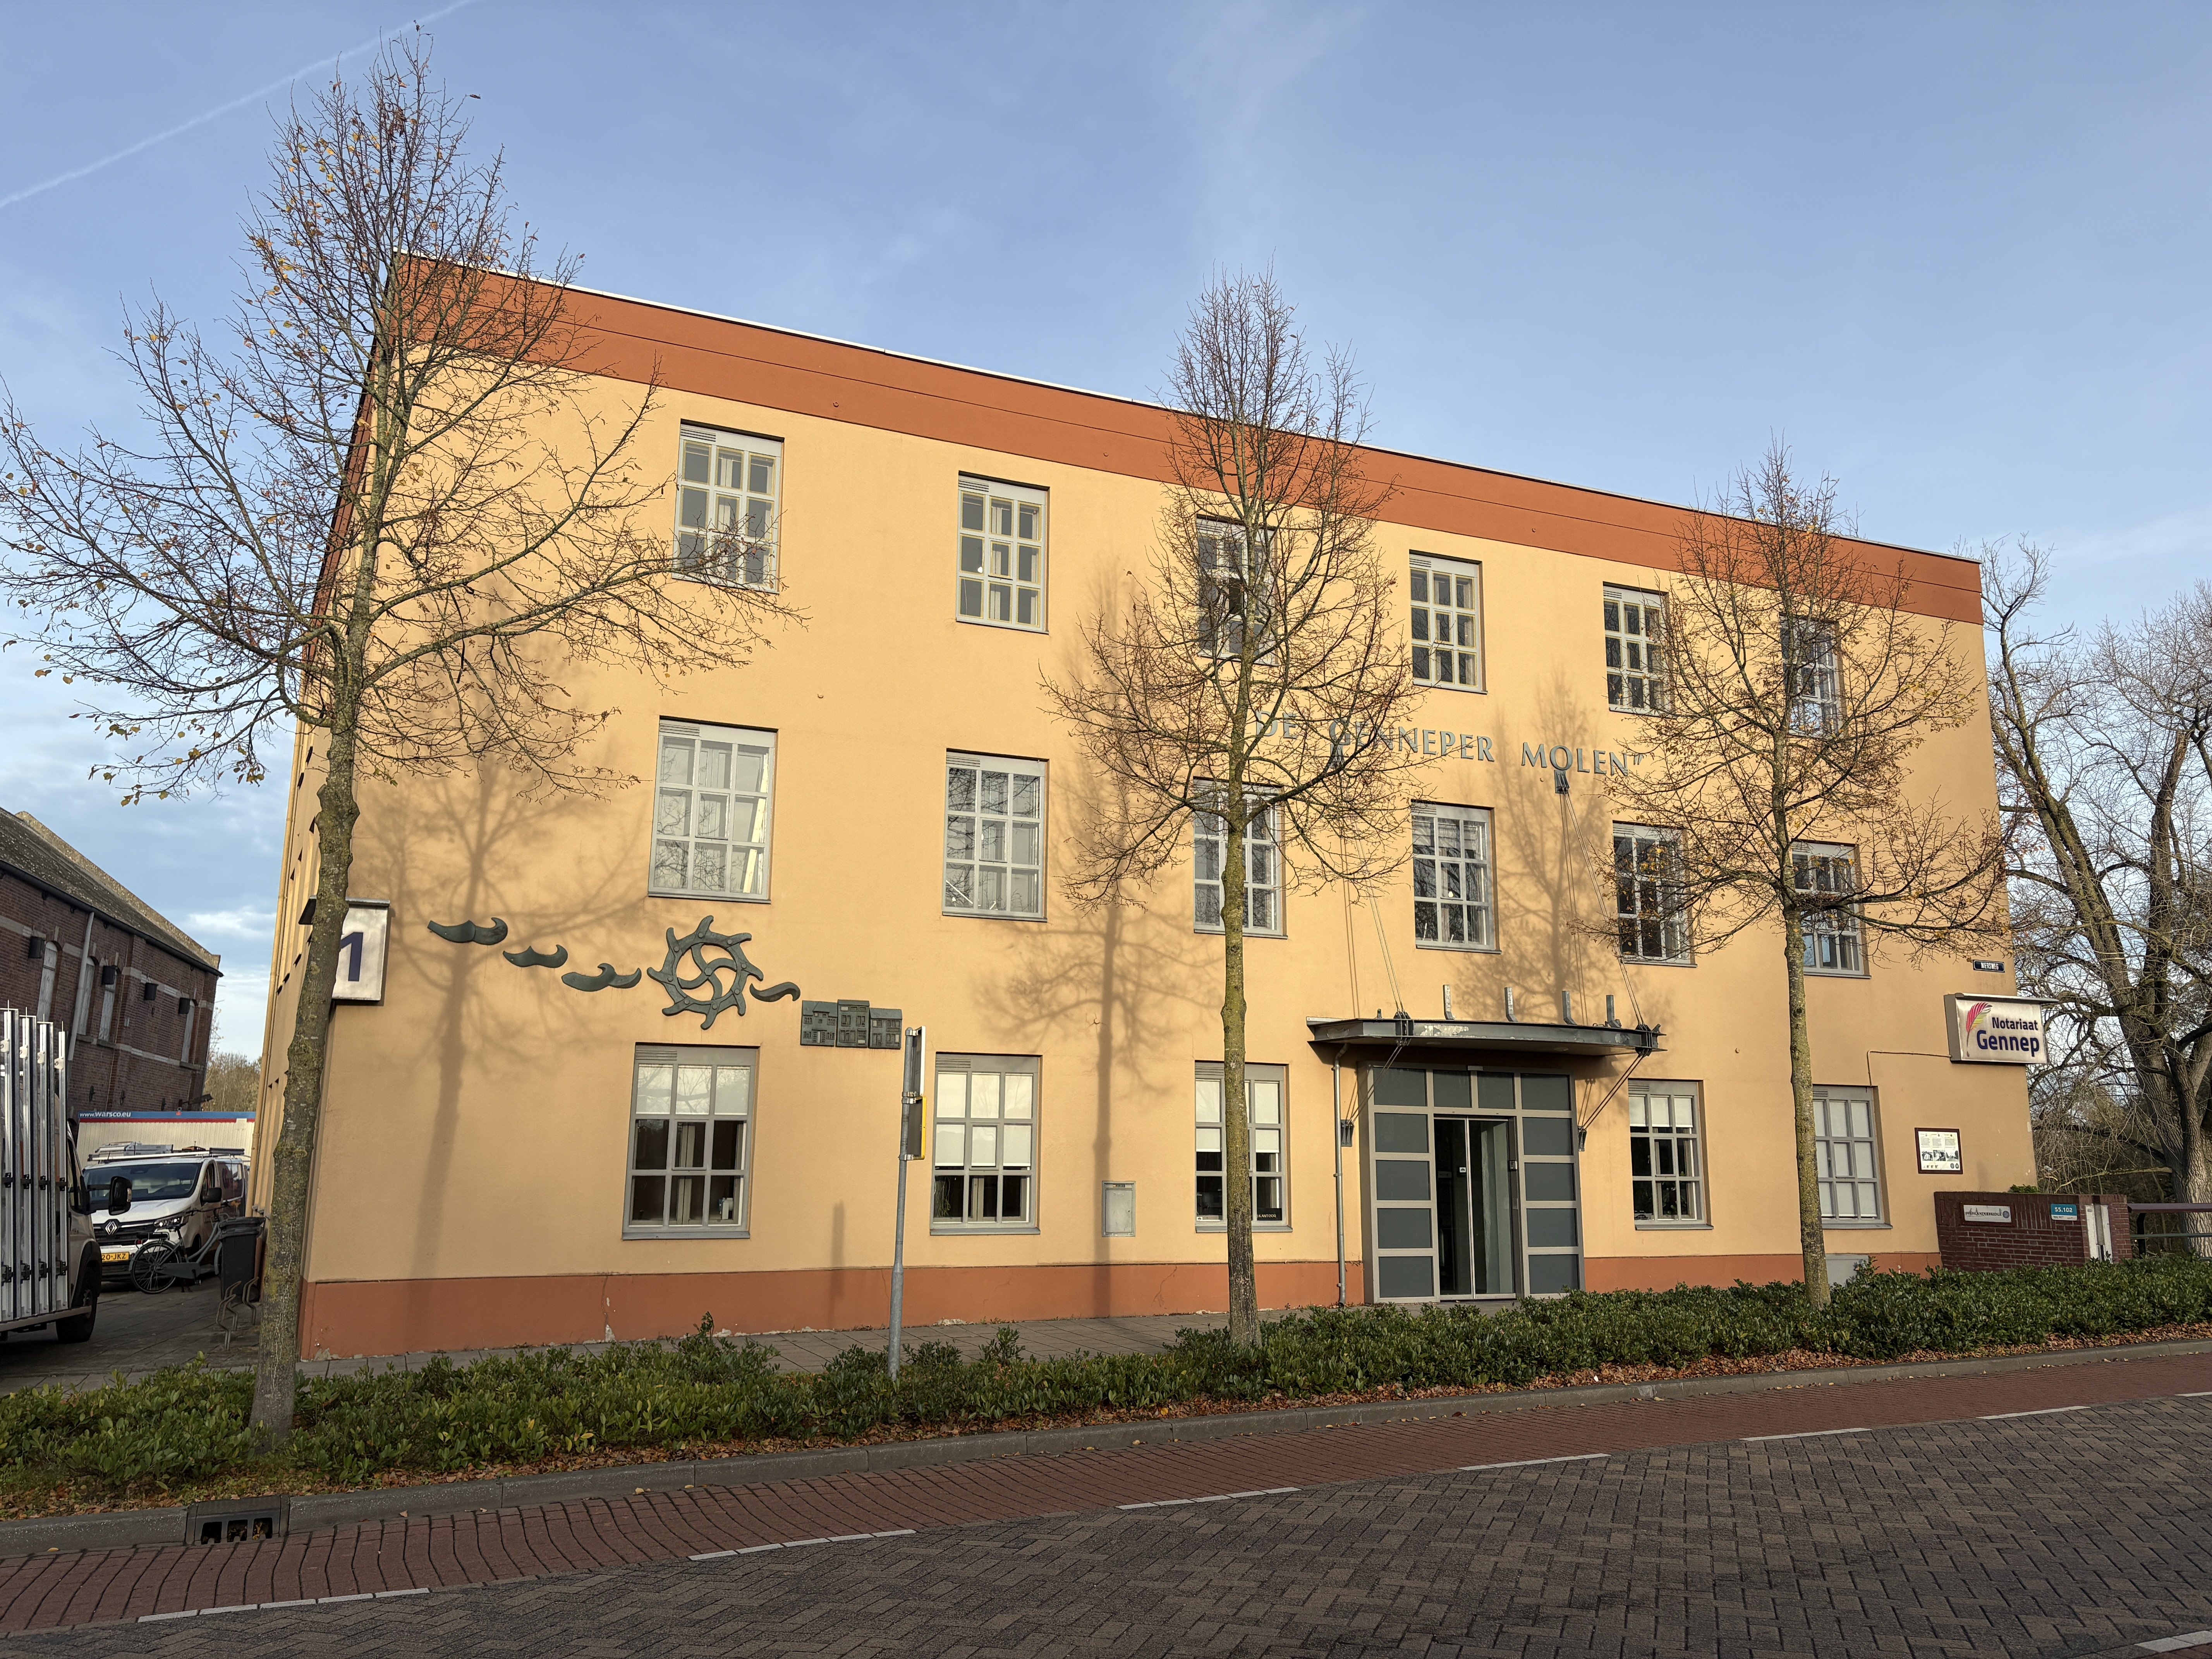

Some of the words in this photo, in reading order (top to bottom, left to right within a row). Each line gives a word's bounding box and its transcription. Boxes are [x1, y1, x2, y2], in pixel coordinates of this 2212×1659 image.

[1255, 710, 1298, 739] DE
[1992, 1017, 2039, 1030] Notariaat
[1977, 1030, 2040, 1057] Gennep
